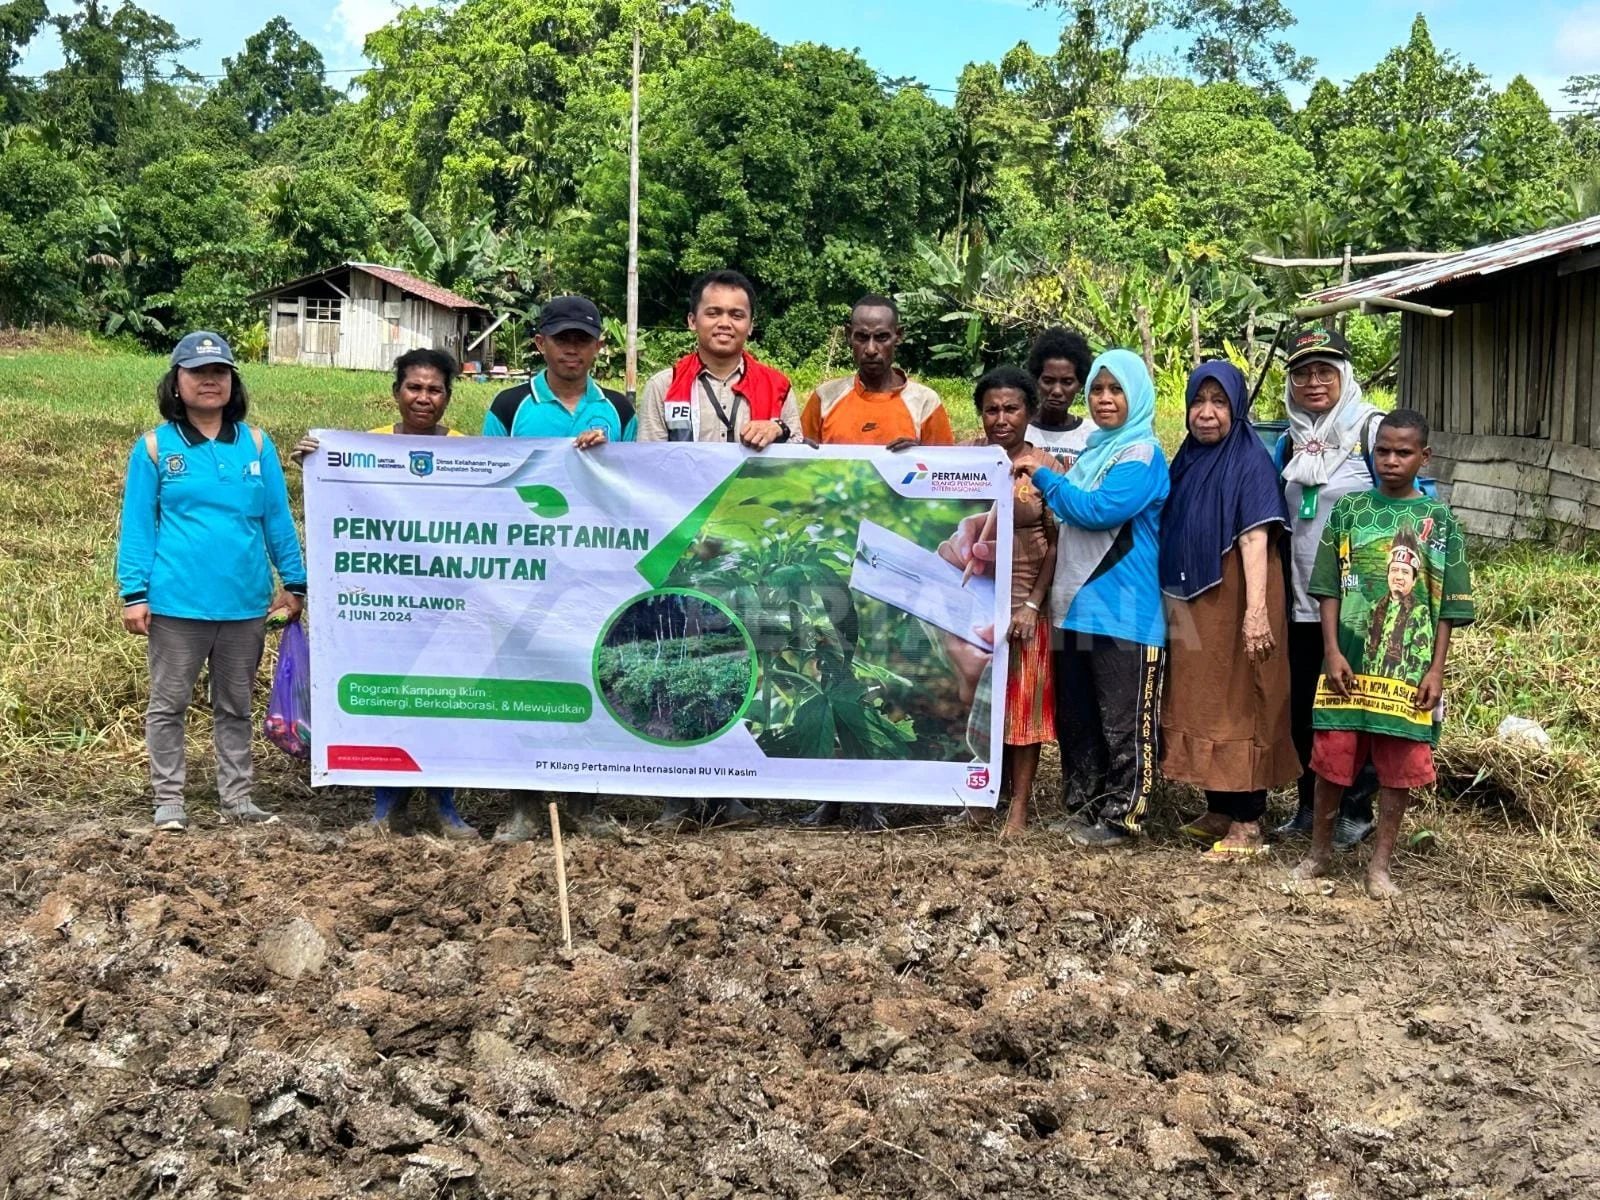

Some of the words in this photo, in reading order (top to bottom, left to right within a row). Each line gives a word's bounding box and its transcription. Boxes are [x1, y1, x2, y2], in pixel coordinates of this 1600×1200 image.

[672, 406, 690, 418] PE
[470, 466, 493, 474] Sorong
[931, 472, 987, 481] PERTAMINA
[333, 517, 498, 545] PENYULUHAN
[507, 523, 649, 551] PERTANIAN
[334, 551, 547, 580] BERKELANJUTAN
[337, 593, 394, 607] DUSUN
[397, 595, 466, 611] KLAWOR
[338, 609, 347, 620] 4
[349, 610, 376, 621] JUNI
[379, 611, 412, 622] 2024
[349, 682, 399, 696] Program
[401, 685, 456, 698] Kampung
[350, 695, 412, 709] Bersinergi,
[414, 698, 499, 711] Berkolaborasi,
[501, 701, 510, 711] &
[513, 702, 585, 714] Mewujudkan
[536, 761, 548, 769] PT
[550, 762, 580, 772] Kilang
[581, 763, 631, 772] Pertamina
[633, 764, 697, 775] Internasional
[699, 767, 712, 775] RU
[728, 768, 757, 776] Kasim
[1142, 742, 1152, 794] SORONG
